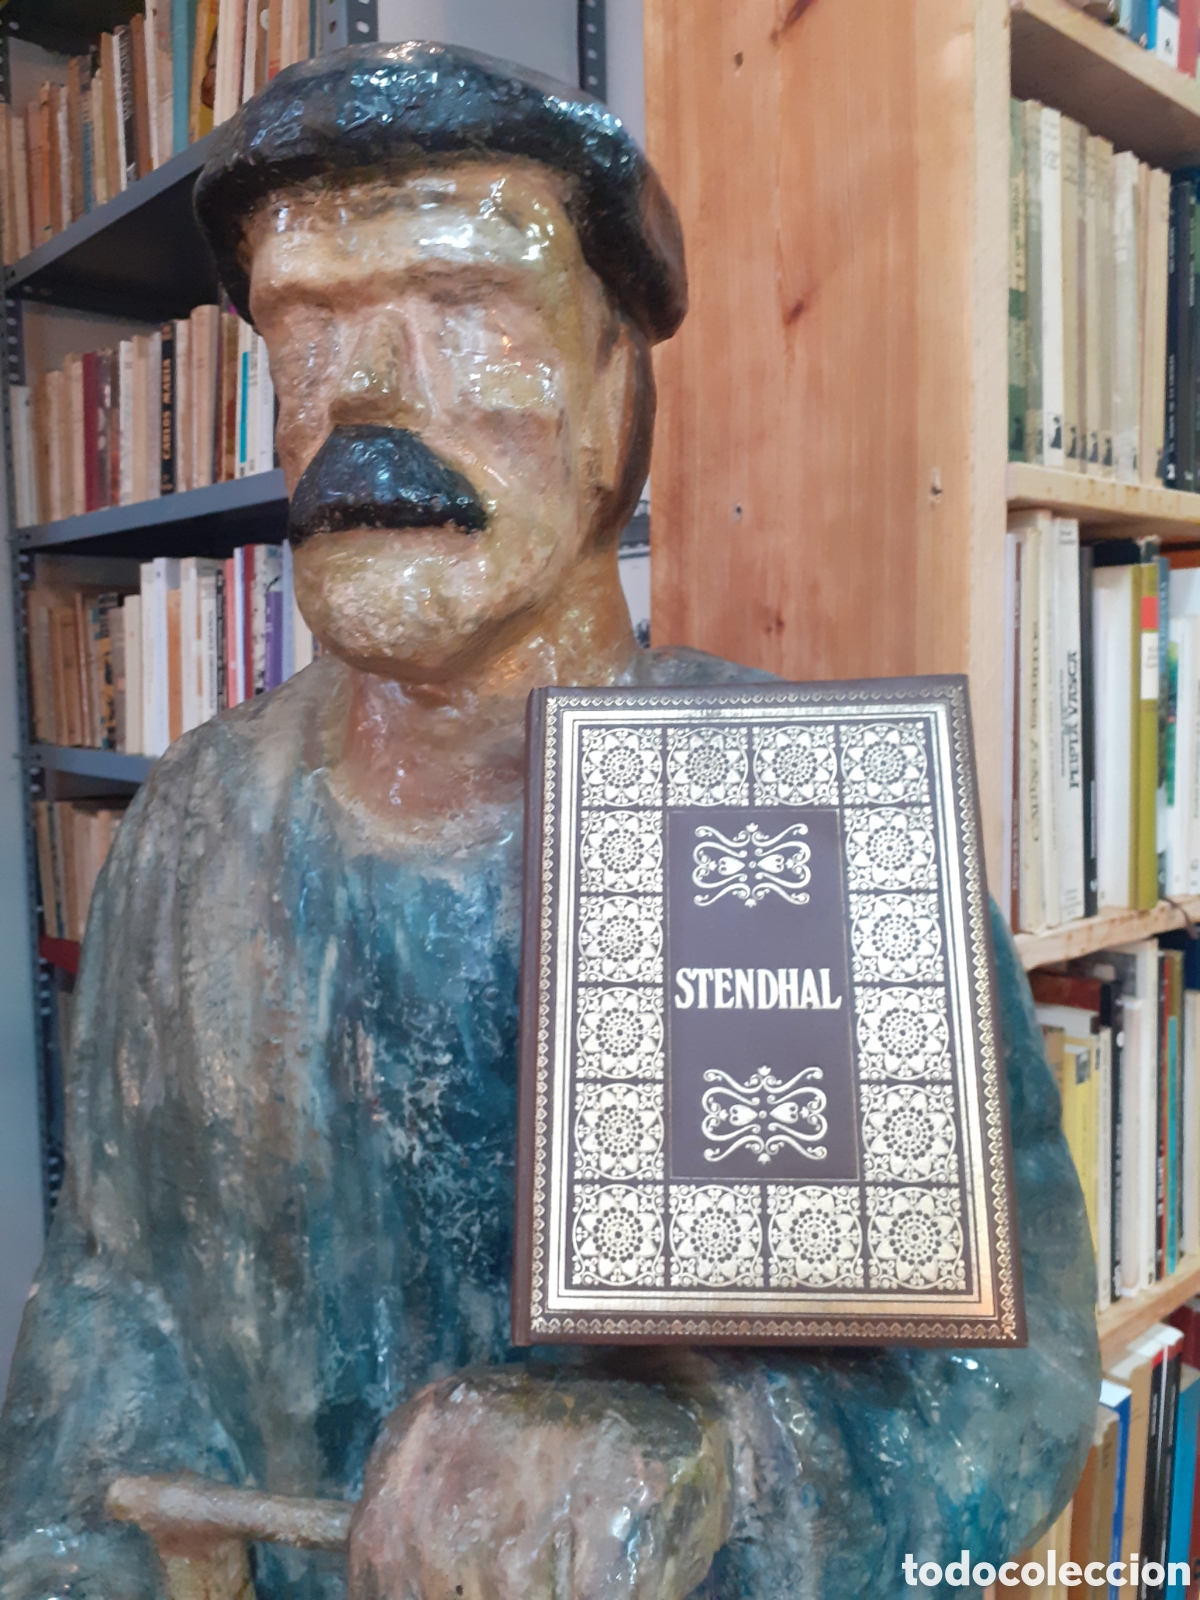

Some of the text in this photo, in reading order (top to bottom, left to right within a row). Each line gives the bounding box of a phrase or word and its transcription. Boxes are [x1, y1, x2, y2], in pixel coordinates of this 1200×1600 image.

[162, 410, 172, 461] CARLOS
[1064, 651, 1078, 720] VASCA
[674, 967, 842, 1010] STENDHAL
